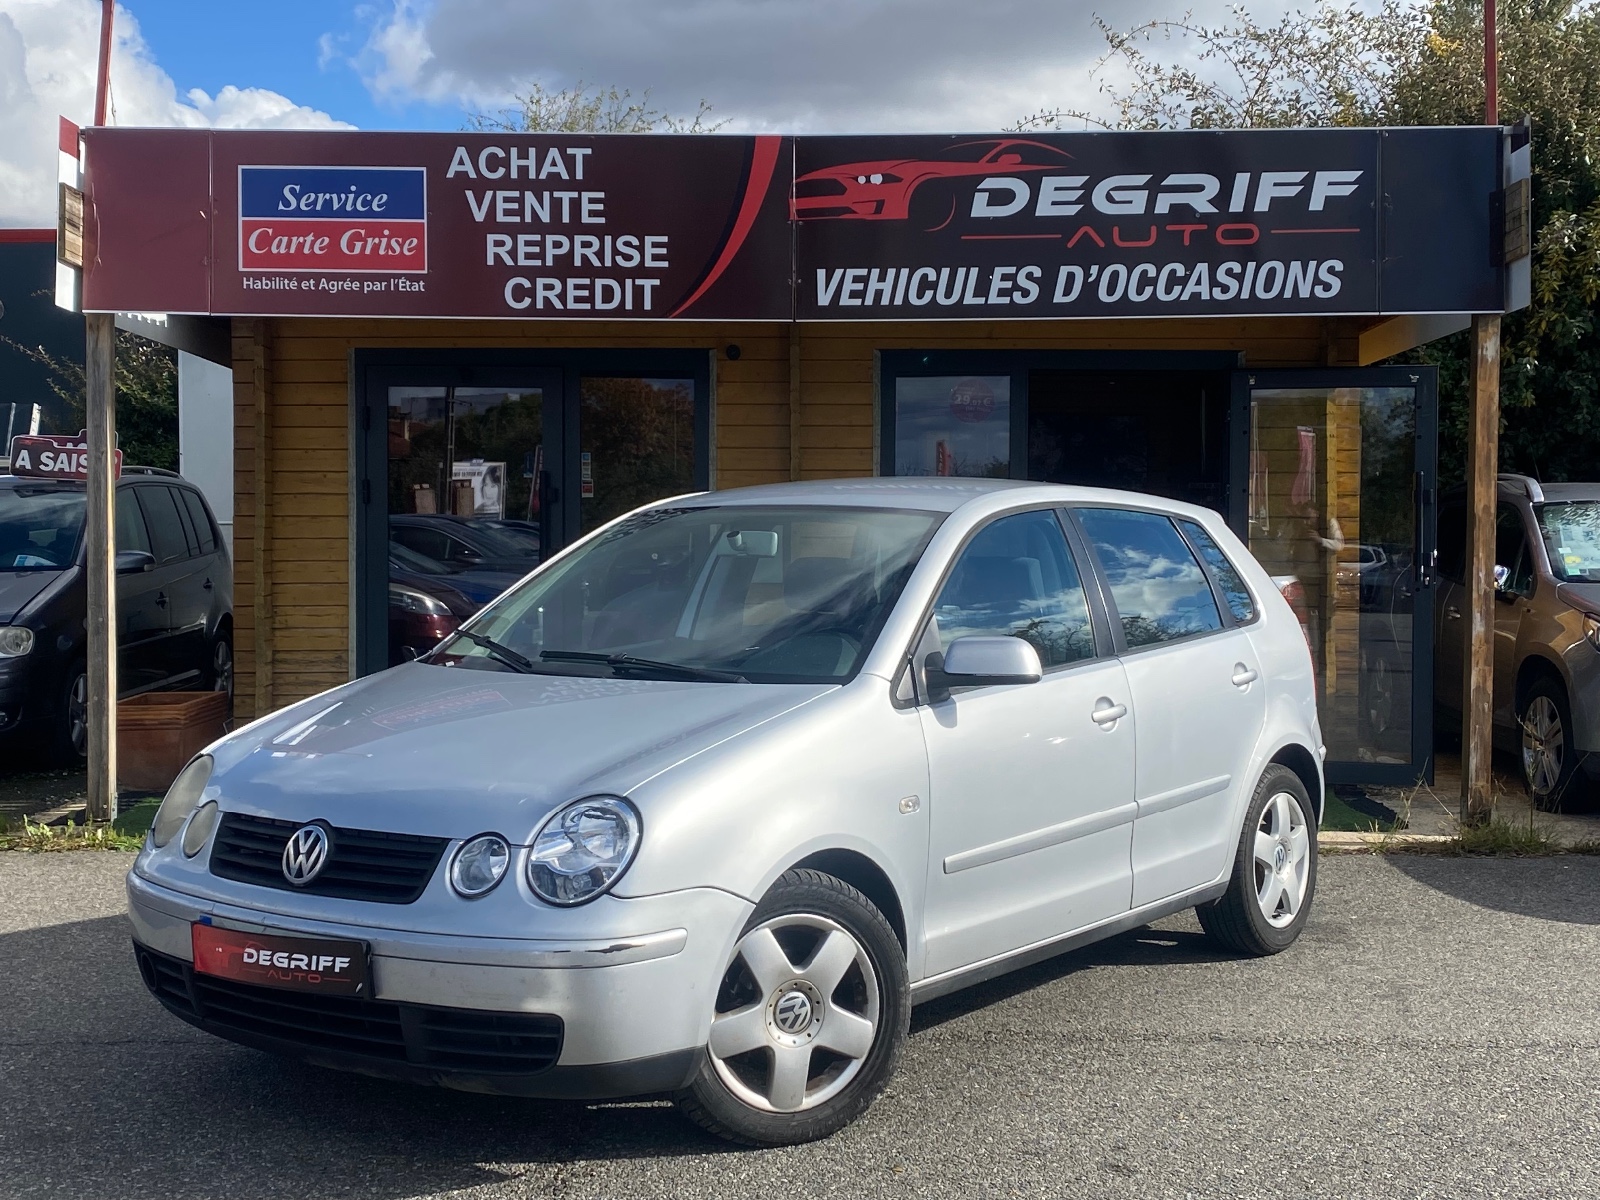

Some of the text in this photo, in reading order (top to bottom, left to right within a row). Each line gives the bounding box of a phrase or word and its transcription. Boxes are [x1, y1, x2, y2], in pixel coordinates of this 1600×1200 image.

[446, 146, 592, 180] ACHAT
[277, 183, 388, 213] Service
[465, 189, 606, 224] VENTE
[970, 170, 1364, 218] DEGRIFF
[248, 227, 419, 256] Carte Grise
[486, 233, 669, 269] REPRISE
[1066, 223, 1260, 249] AUTO
[243, 276, 299, 291] Habilité
[300, 278, 316, 291] et
[318, 277, 361, 294] Agrée
[363, 281, 388, 295] par
[504, 276, 660, 311] CREDIT
[815, 259, 1344, 307] VEHICULES D'OCCASIONS
[15, 449, 32, 470] A
[243, 948, 351, 973] DEGRIFF
[267, 970, 321, 984] AUTO
